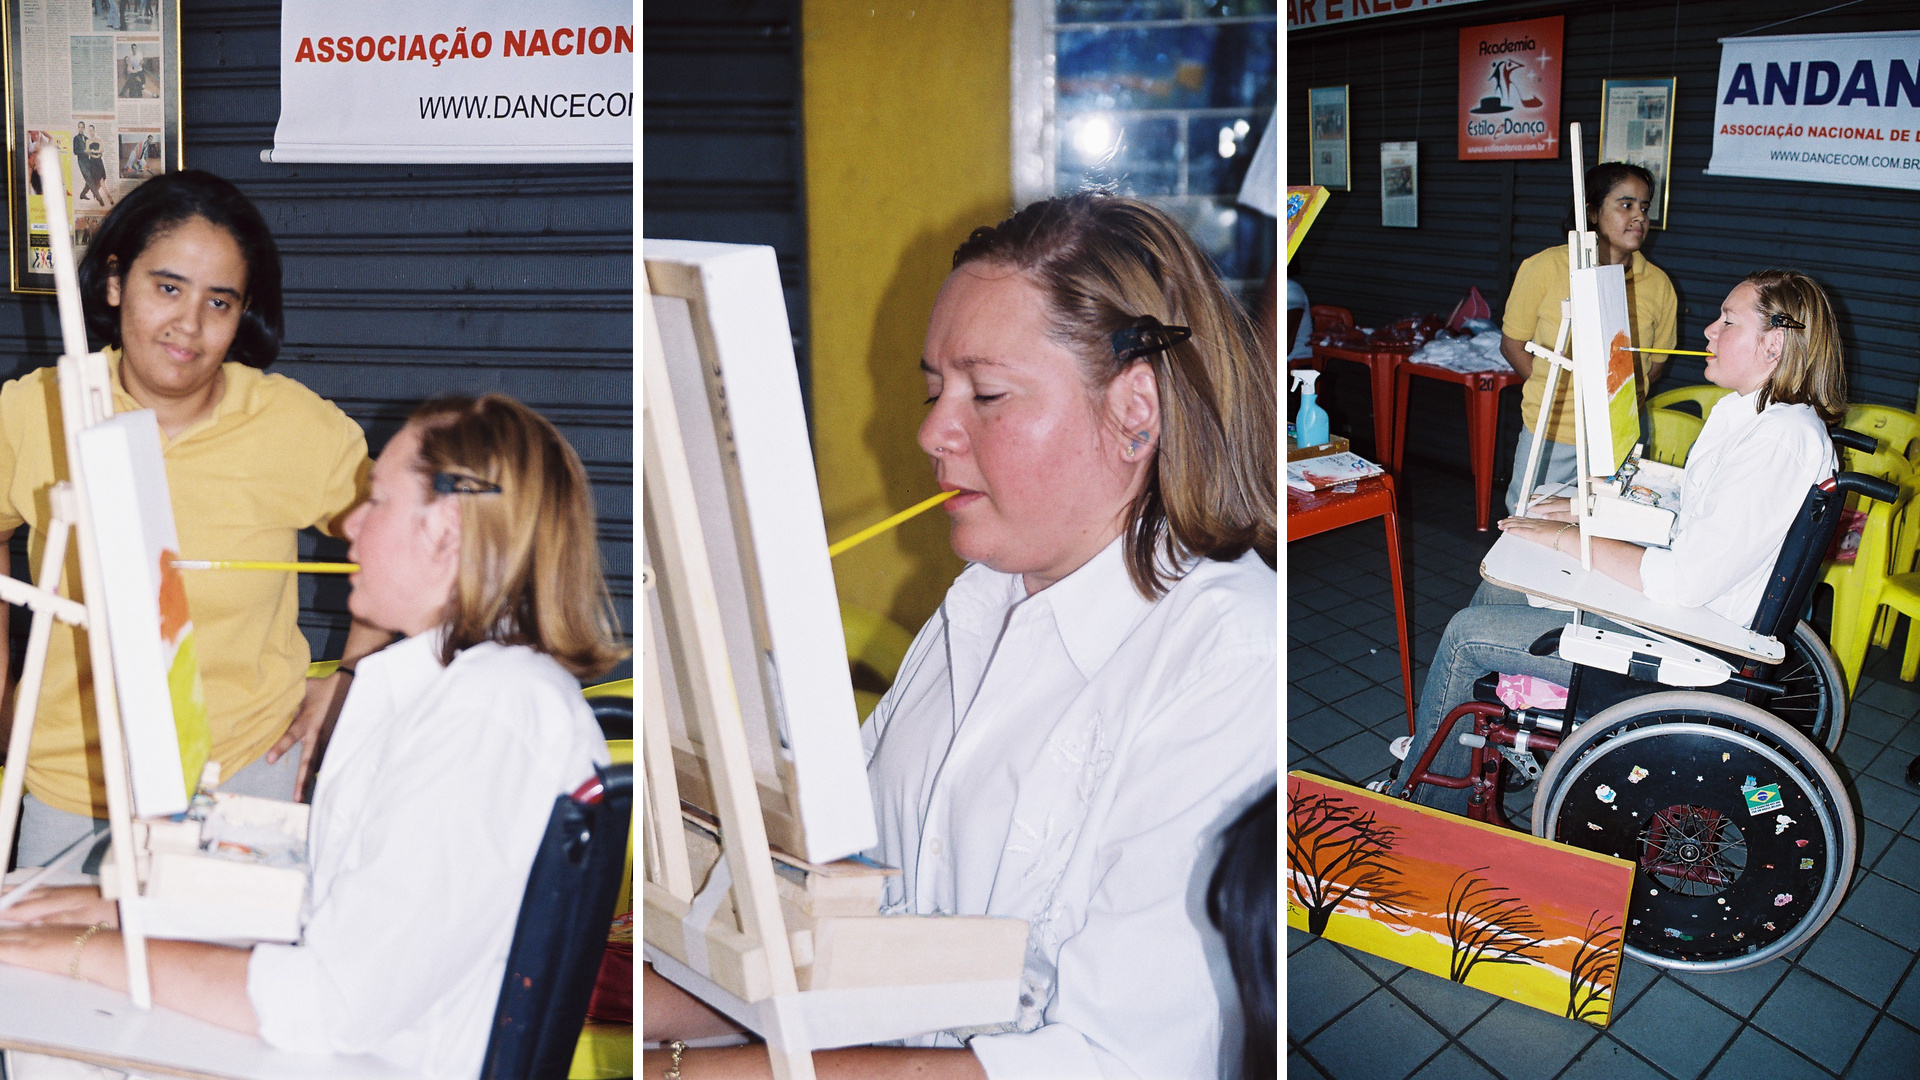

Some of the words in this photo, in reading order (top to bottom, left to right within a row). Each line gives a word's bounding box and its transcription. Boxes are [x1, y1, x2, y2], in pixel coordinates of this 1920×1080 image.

[294, 26, 493, 67] ASSOCIAÇÃO
[503, 25, 633, 57] NACION
[1479, 35, 1536, 56] Academia
[1722, 59, 1920, 108] ANDAN
[419, 92, 633, 119] WWW.DANCECO
[1467, 119, 1495, 136] Estilo
[1504, 118, 1545, 136] Dança
[1720, 123, 1803, 139] ASSOCIAÇÃO
[1807, 126, 1884, 141] NACIONAL
[1889, 129, 1910, 142] DE
[1770, 150, 1920, 170] WWW.DANCECOM.COM.BR
[1480, 378, 1494, 391] 20
